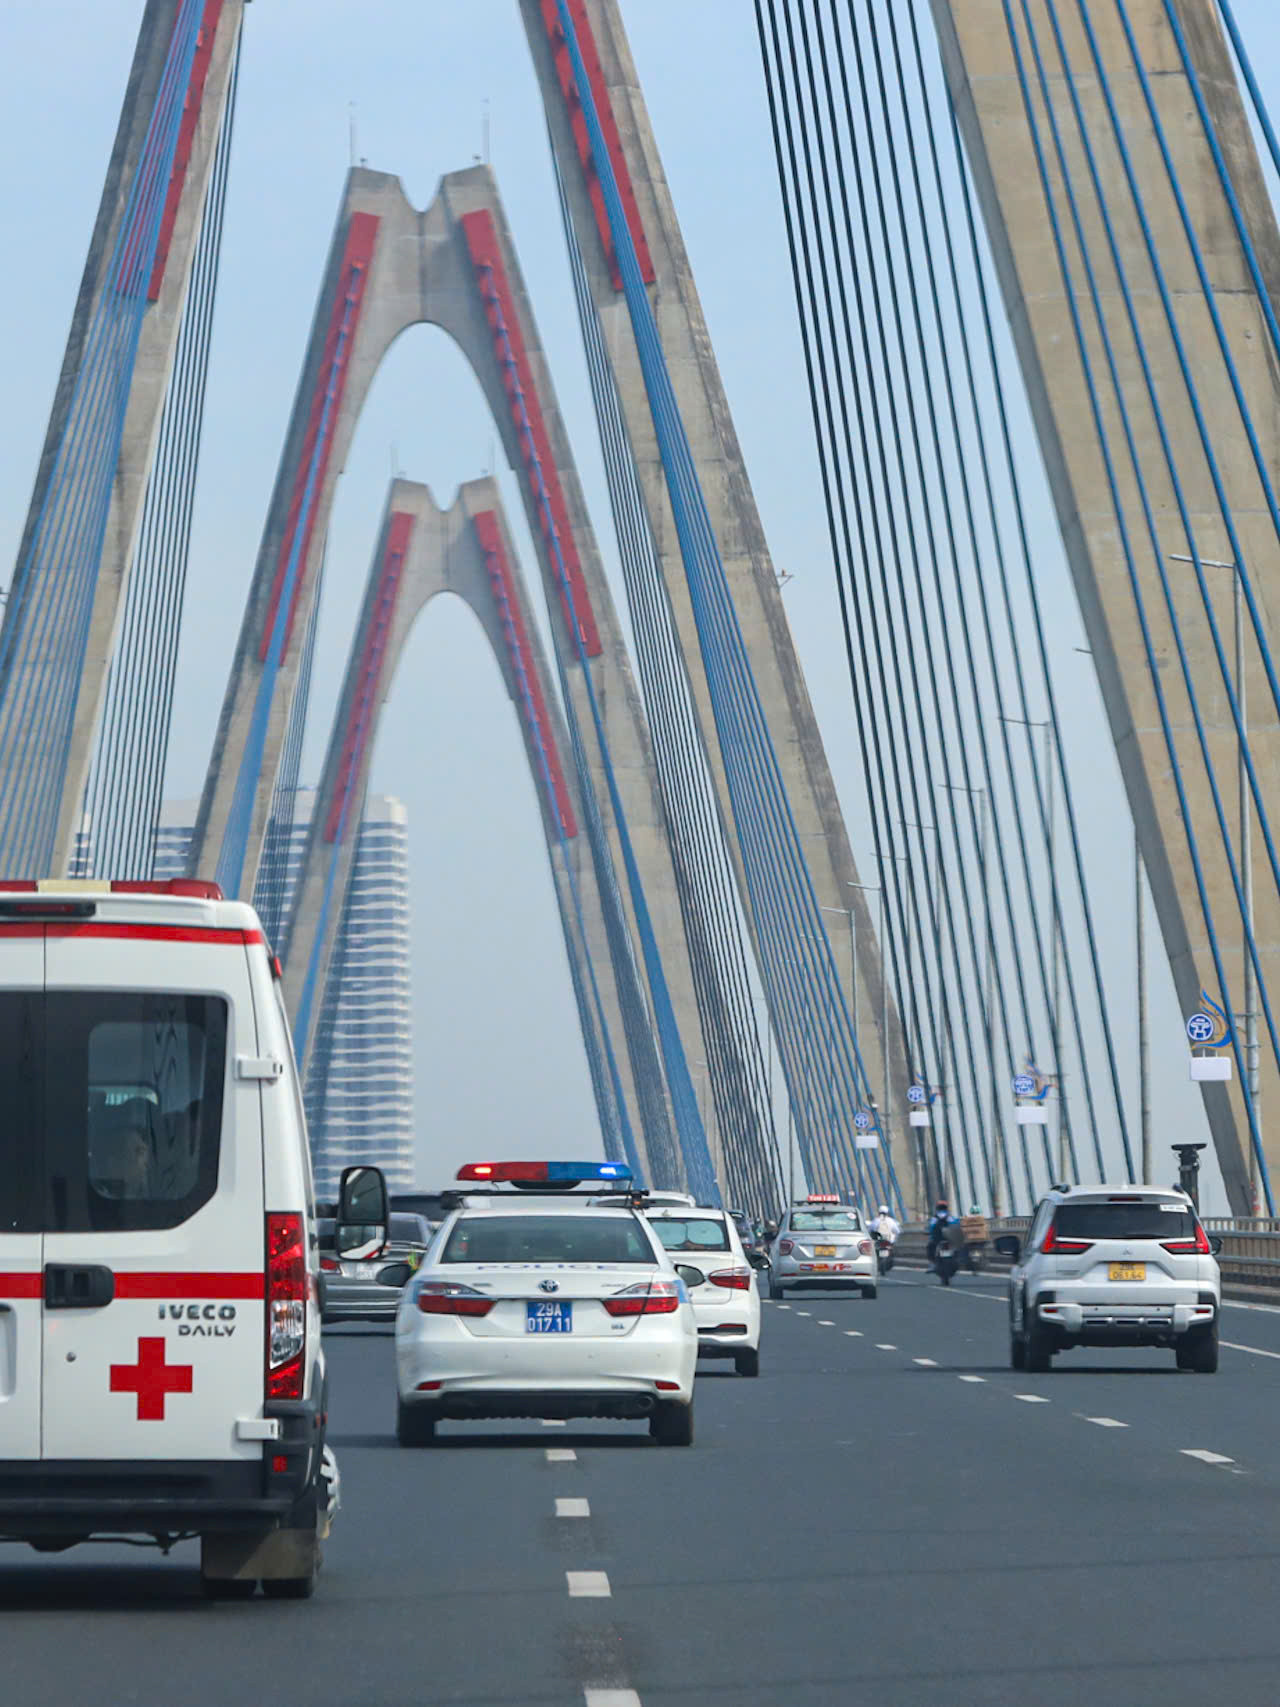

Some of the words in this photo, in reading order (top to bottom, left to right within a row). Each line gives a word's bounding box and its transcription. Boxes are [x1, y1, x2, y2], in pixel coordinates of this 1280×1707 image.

[158, 1303, 237, 1321] IVECO
[536, 1302, 563, 1317] 29A
[178, 1324, 237, 1337] DAILY
[527, 1316, 571, 1333] 017.11
